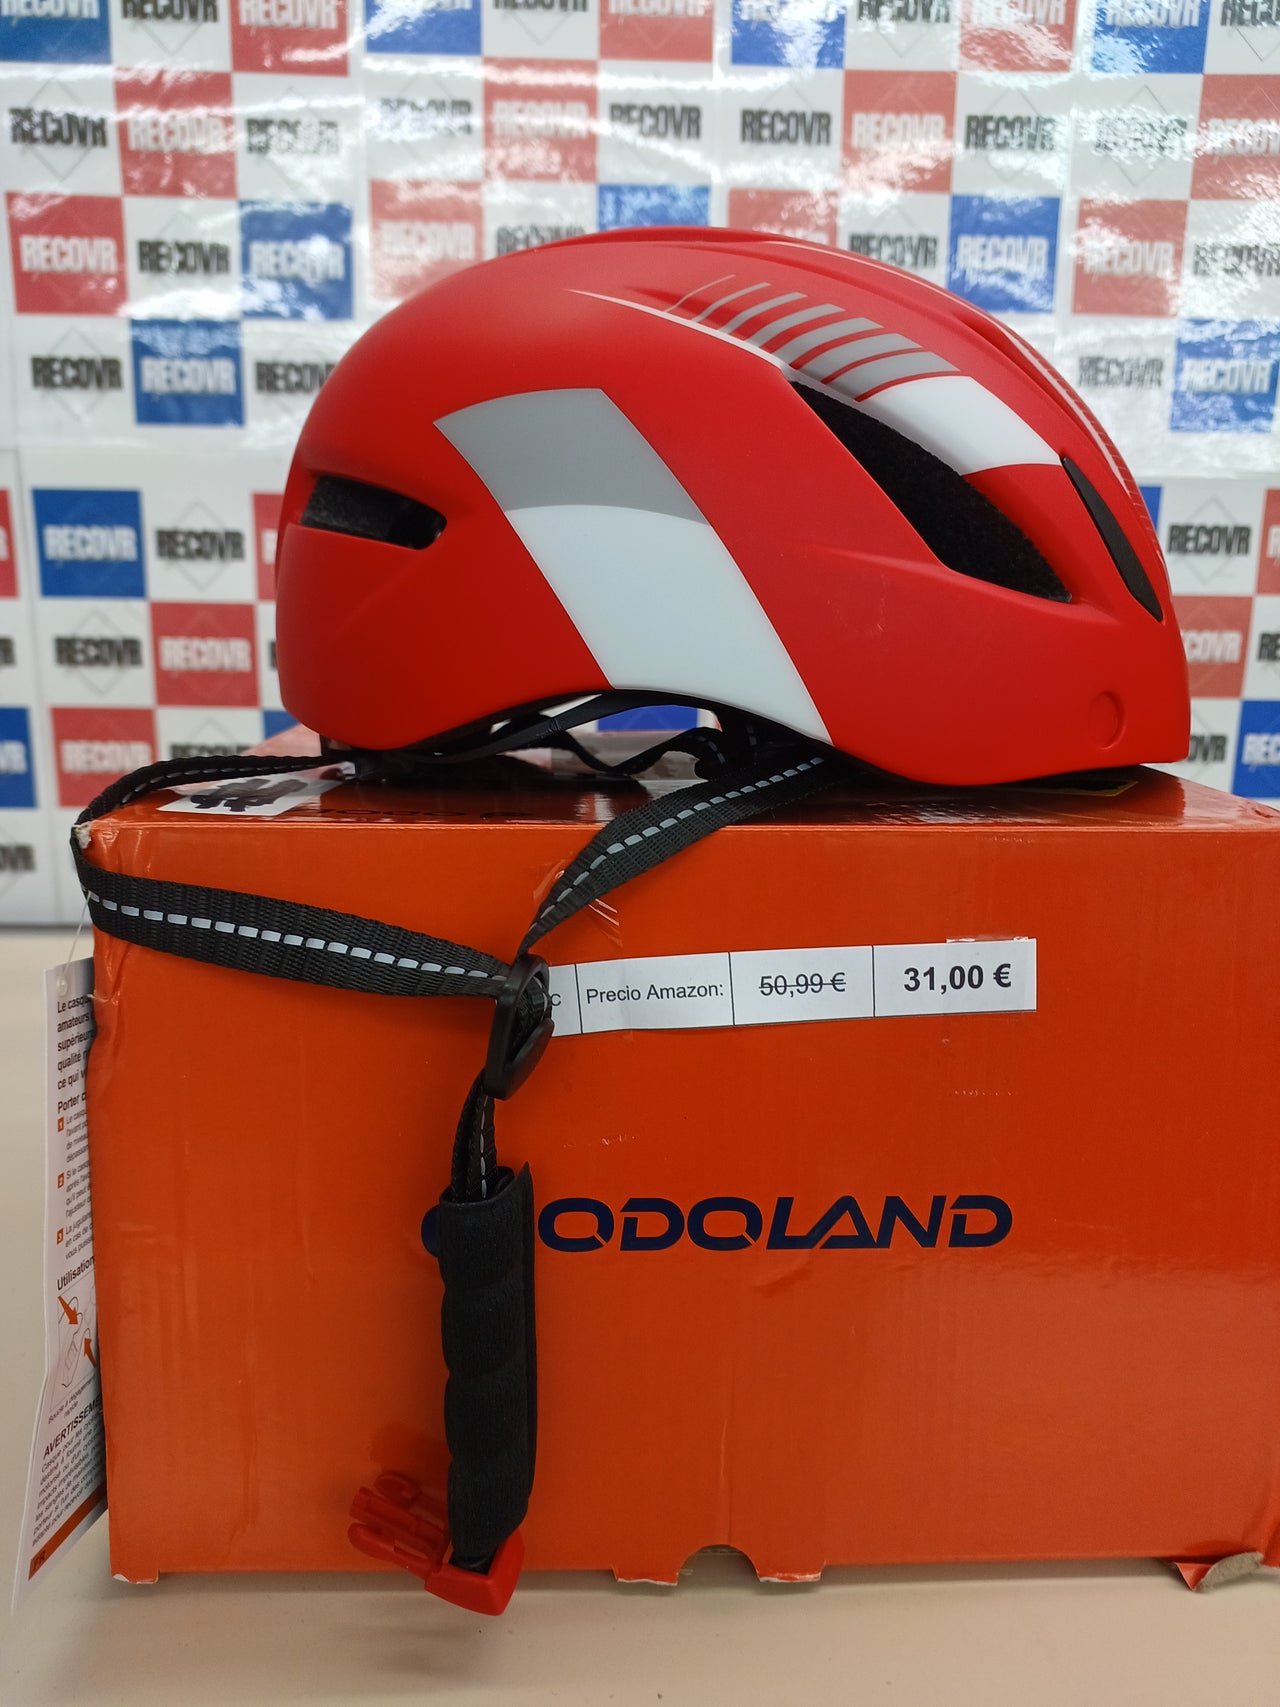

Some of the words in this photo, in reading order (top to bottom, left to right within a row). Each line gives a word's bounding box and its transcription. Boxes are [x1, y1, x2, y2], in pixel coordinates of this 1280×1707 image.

[1221, 0, 1280, 26] RECO
[10, 108, 107, 146] RECOVR
[741, 109, 830, 145] RECOVR
[850, 113, 946, 149] RECOVR
[20, 236, 118, 273] RECOVR
[138, 240, 229, 274] RECOVR
[250, 242, 344, 279] RECOVR
[957, 234, 1048, 274] RECOVR
[31, 357, 122, 389] RECOVR
[141, 358, 236, 393] RECOVR
[1181, 359, 1272, 393] RECOVR
[45, 526, 137, 560] RECOVR
[157, 530, 244, 560] RECOVR
[1168, 525, 1250, 555] RECOVR
[55, 638, 141, 667] RECOVR
[160, 637, 251, 671] RECOVR
[62, 740, 153, 774] RECOVR
[587, 985, 641, 1004] Precio
[647, 984, 723, 1000] Amazon:
[759, 973, 824, 998] 50,99
[831, 972, 846, 993] €
[903, 965, 984, 995] 31,00
[993, 963, 1012, 988] €
[57, 1001, 67, 1013] Le
[57, 1012, 89, 1032] amateurs
[57, 1049, 81, 1073] qualité
[57, 1079, 67, 1090] ce
[68, 1068, 79, 1086] qui
[57, 1094, 80, 1114] Porter
[538, 1195, 1013, 1253] ODOLAND
[57, 1255, 95, 1291] Utilisation
